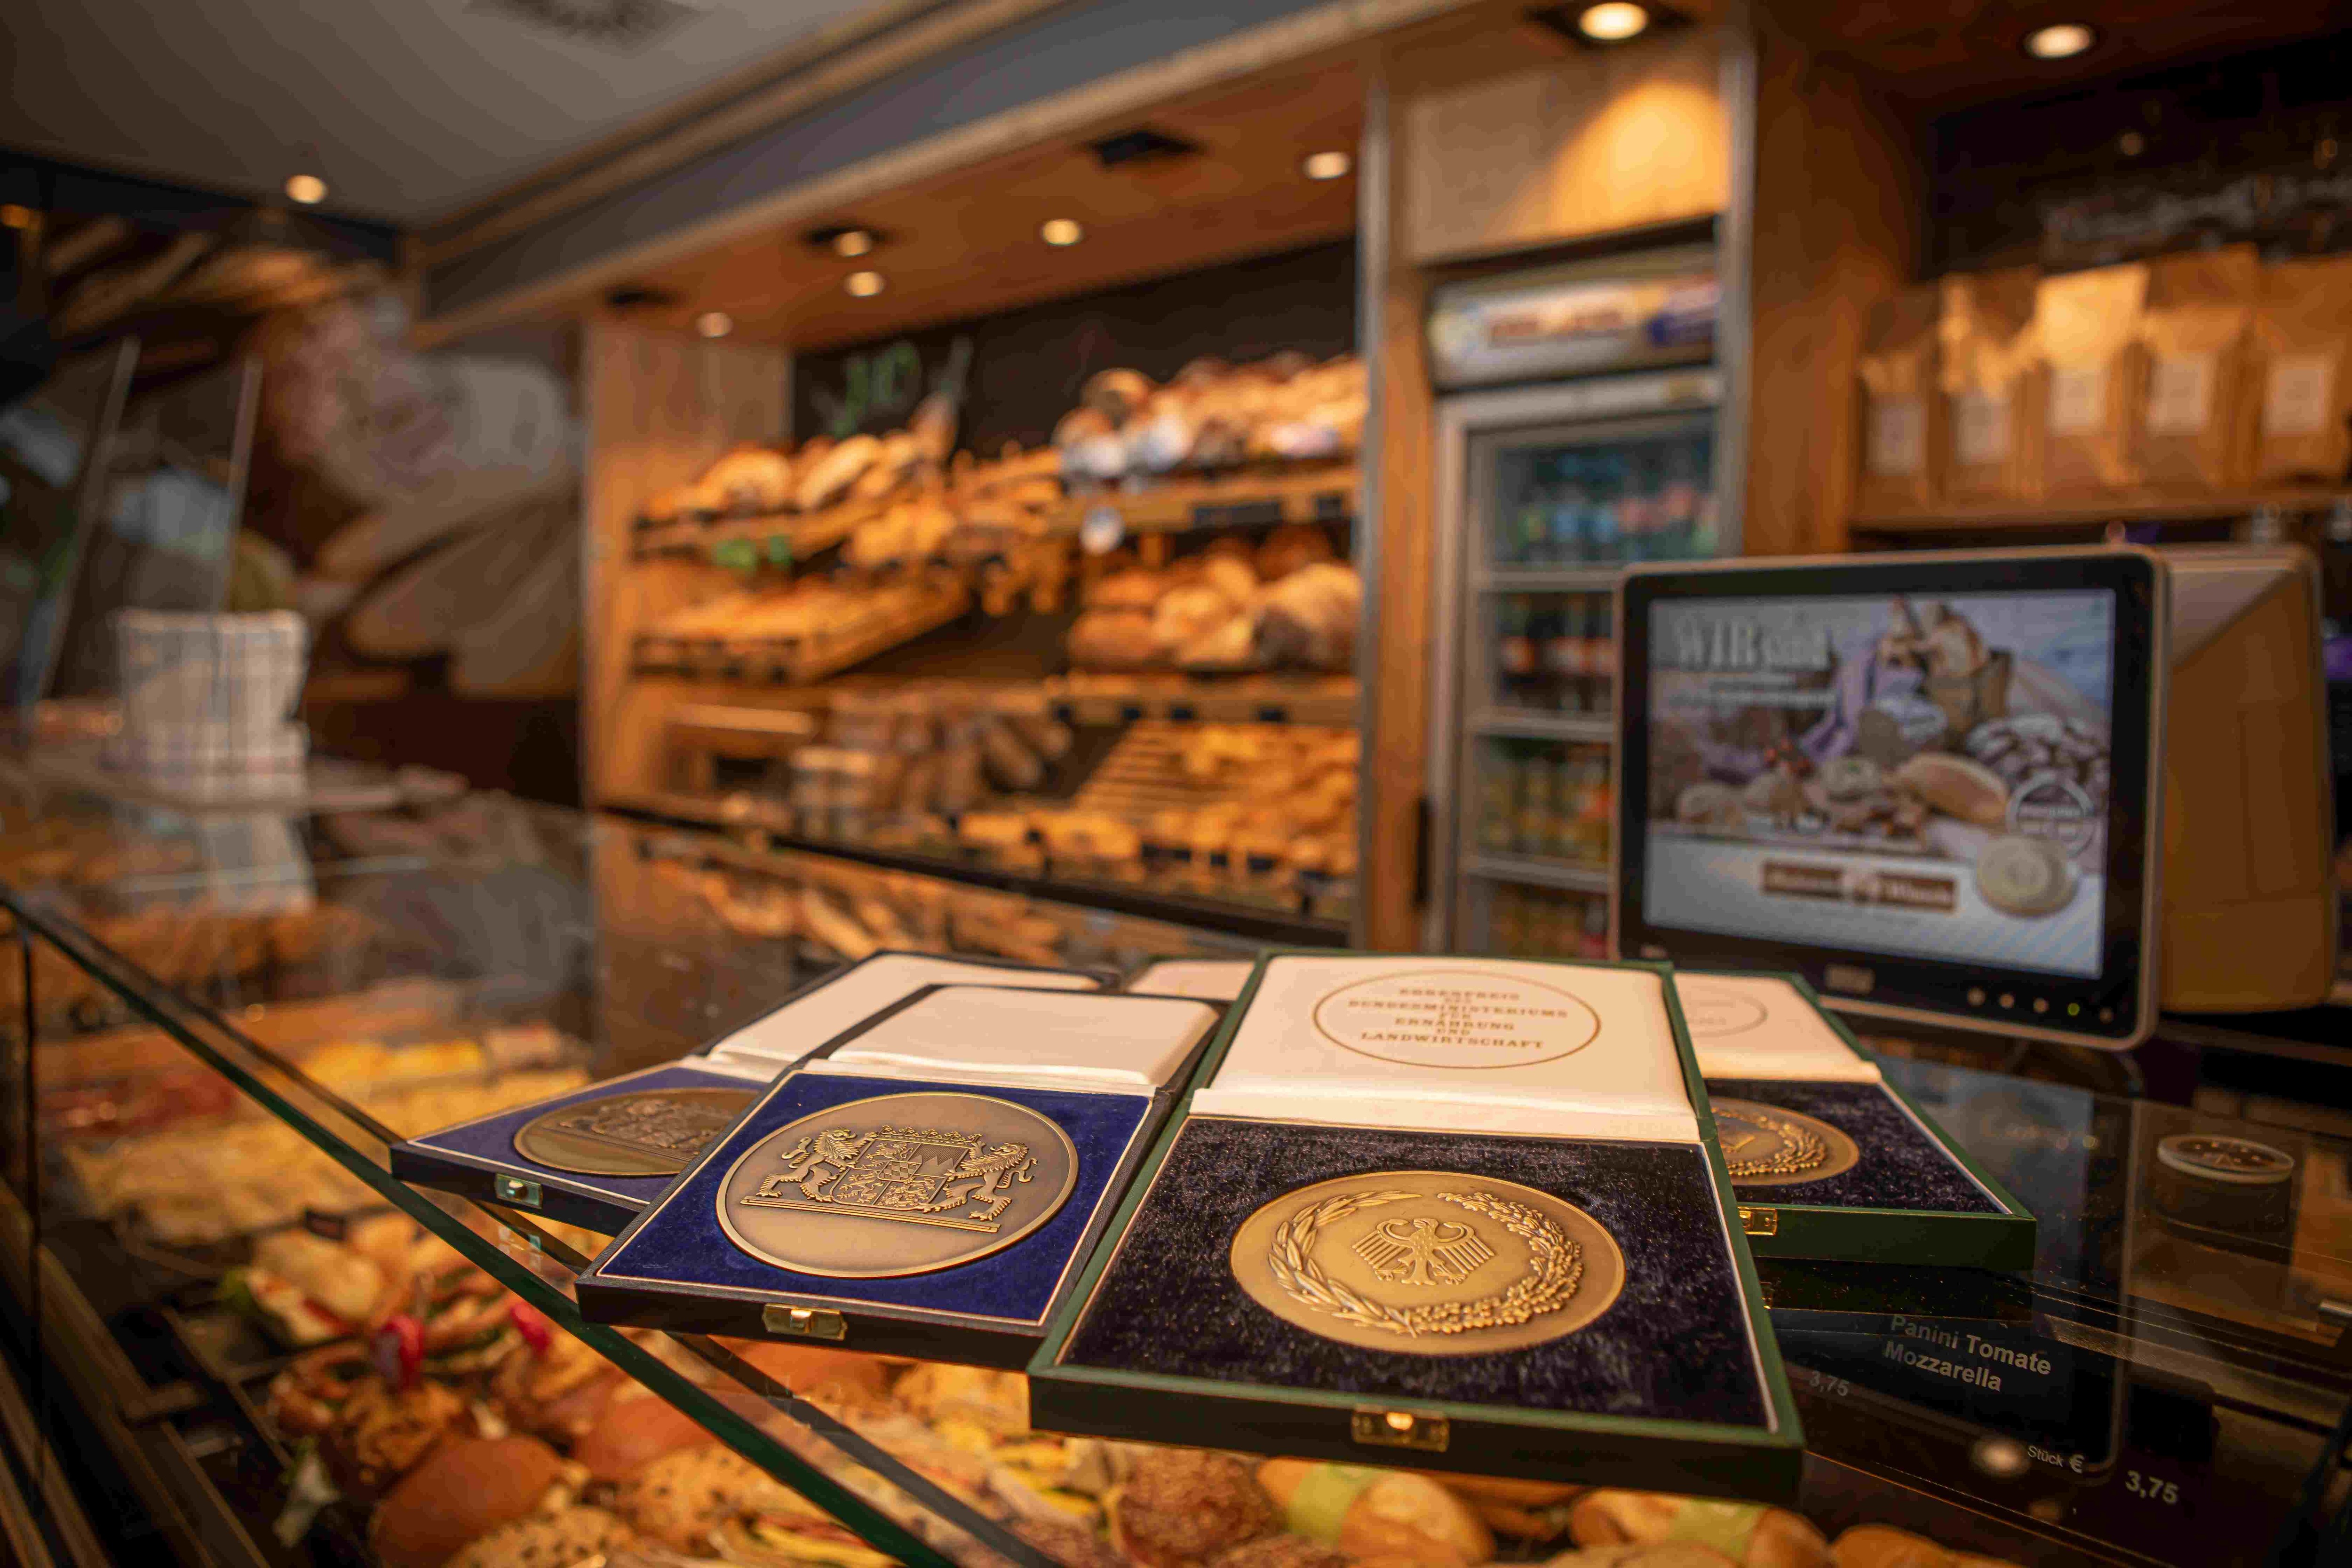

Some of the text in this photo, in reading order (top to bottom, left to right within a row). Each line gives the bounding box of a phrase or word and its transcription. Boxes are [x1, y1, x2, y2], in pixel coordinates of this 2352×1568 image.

[1399, 988, 1519, 1000] EHRENPREIS
[1348, 1000, 1568, 1018] BUNDESMINISTERIUMS
[1395, 1018, 1514, 1030] ERNÄHRUNG
[1361, 1032, 1543, 1049] LANDWIRTSCHAFT
[1891, 1315, 2051, 1375] Panini Tomate
[1884, 1340, 2002, 1392] Mozzarella
[1809, 1370, 1849, 1397] 3,75
[2027, 1445, 2179, 1504] Stück € 3,75
